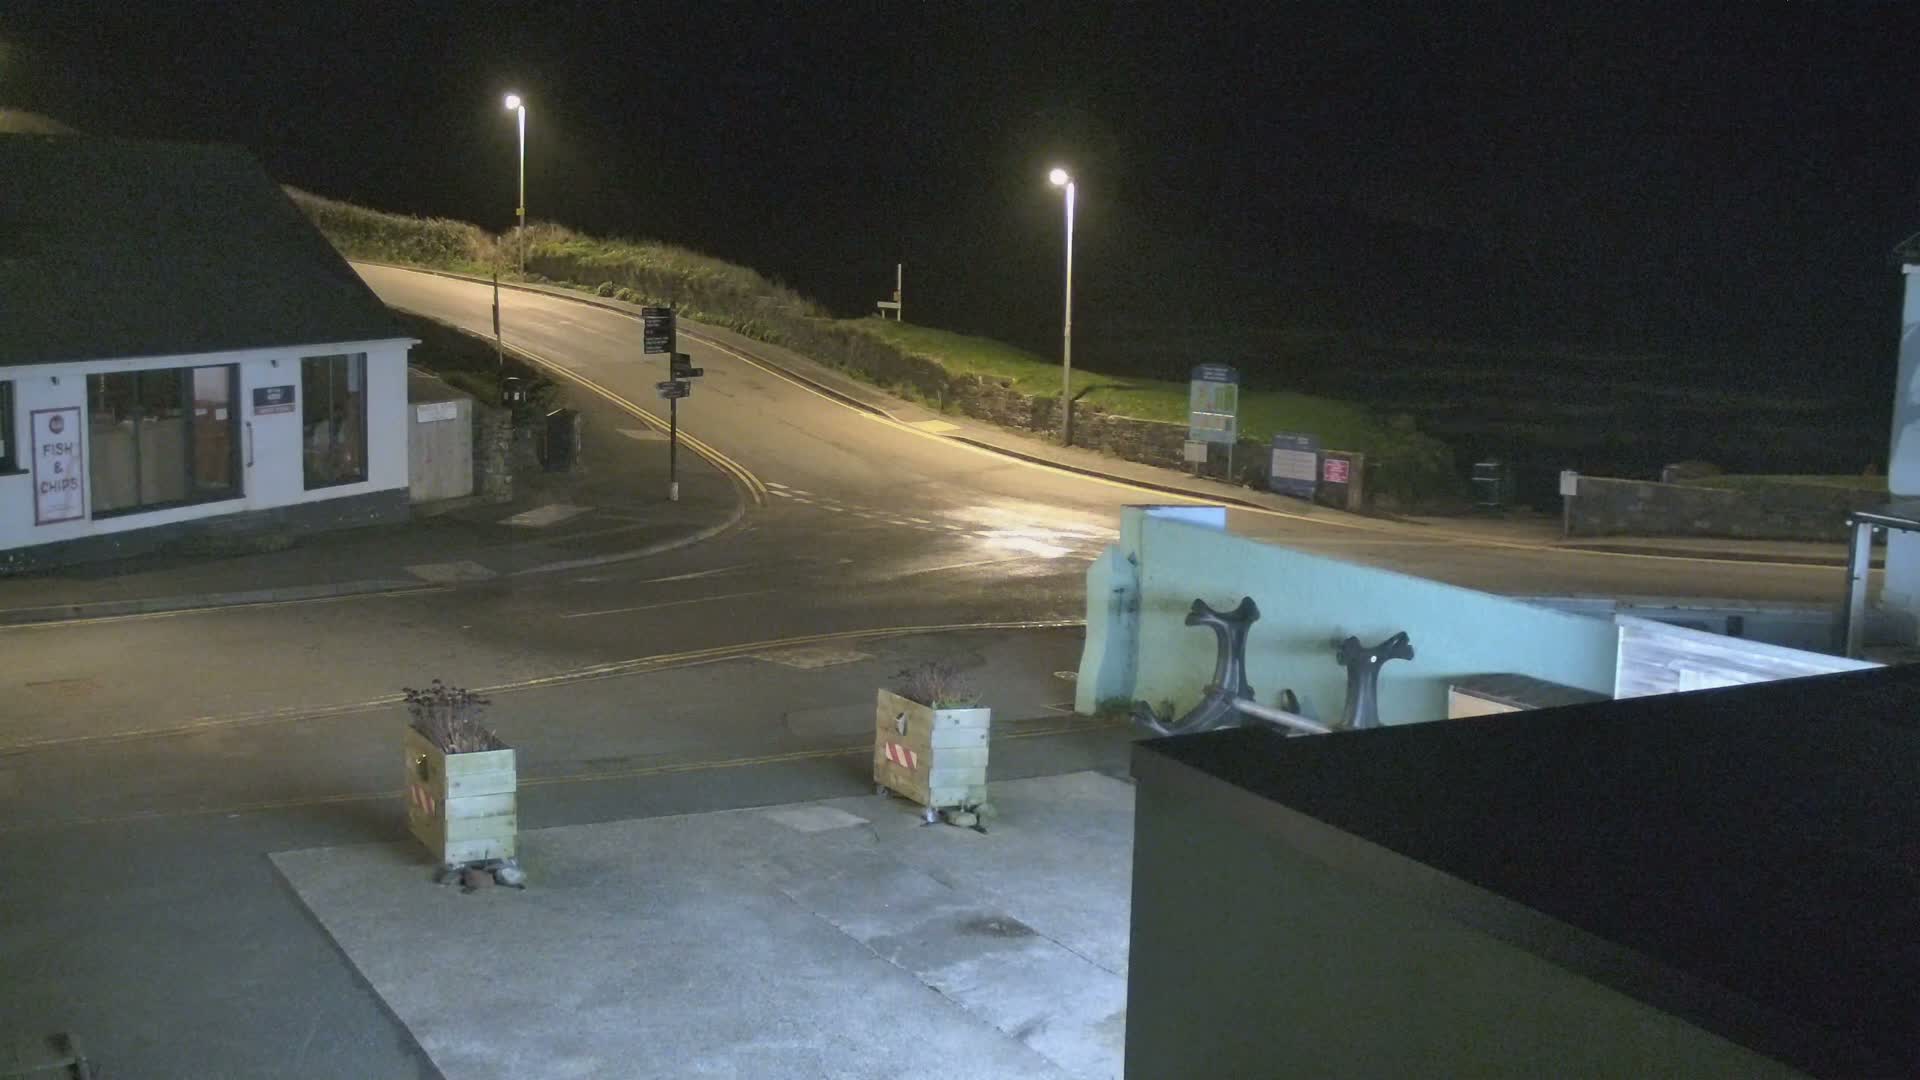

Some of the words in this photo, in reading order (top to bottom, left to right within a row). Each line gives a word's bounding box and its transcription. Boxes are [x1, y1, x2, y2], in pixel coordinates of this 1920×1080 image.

[43, 442, 73, 457] FISH
[53, 461, 64, 474] &
[40, 478, 79, 494] CHIPS
